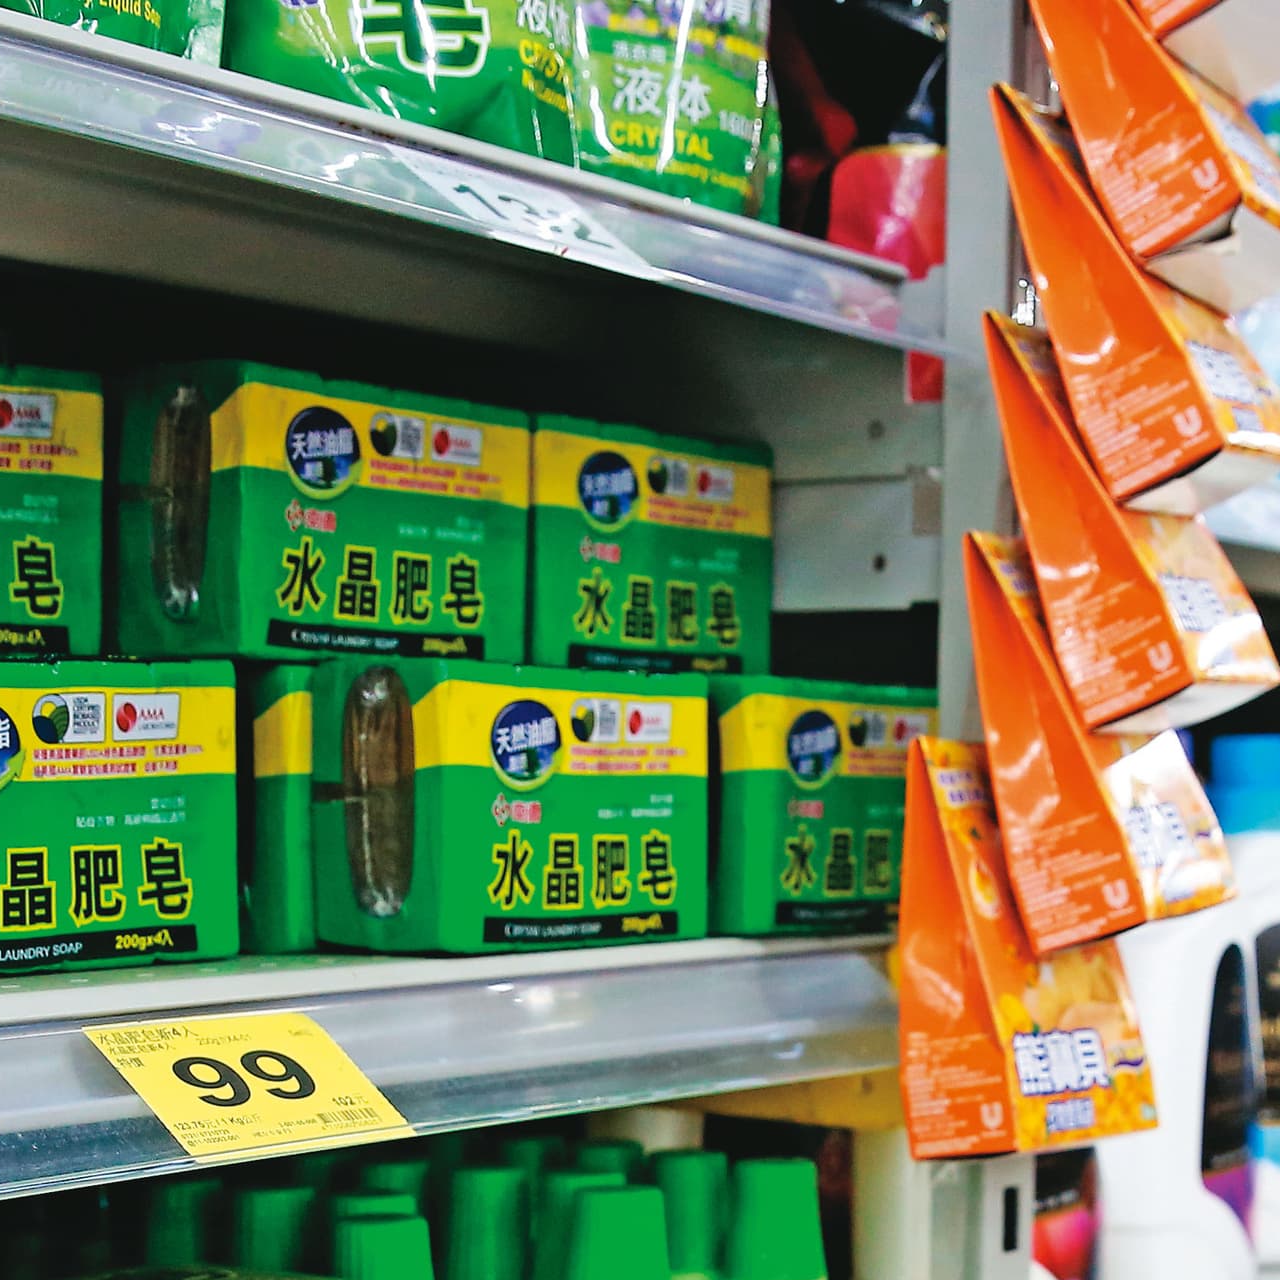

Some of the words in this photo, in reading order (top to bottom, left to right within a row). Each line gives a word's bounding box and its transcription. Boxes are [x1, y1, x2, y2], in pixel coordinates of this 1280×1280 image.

[610, 121, 713, 161] CRYTAL
[276, 536, 484, 628] 水晶肥皂
[573, 567, 741, 648] 水晶肥皂
[488, 828, 677, 911] 水晶肥皂
[52, 940, 83, 956] SOAP
[172, 1049, 316, 1108] 99
